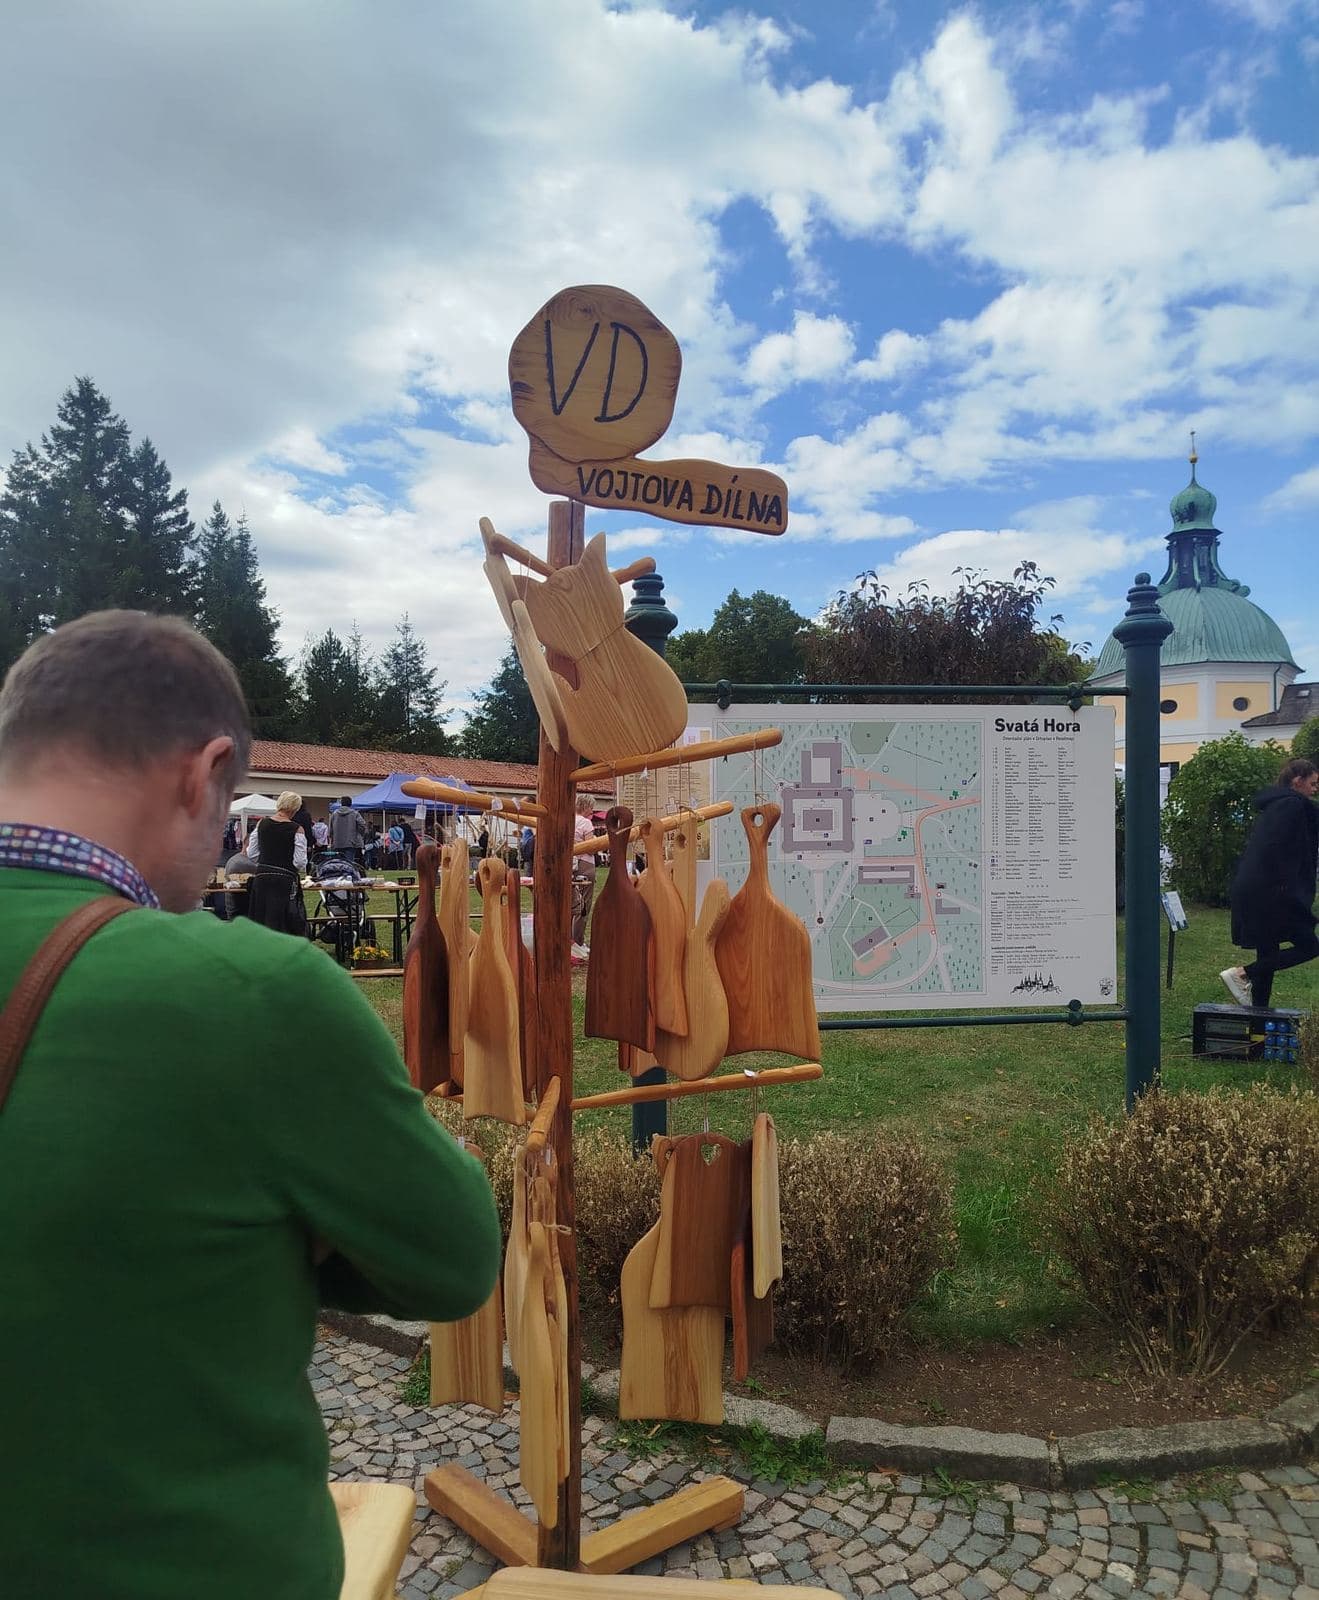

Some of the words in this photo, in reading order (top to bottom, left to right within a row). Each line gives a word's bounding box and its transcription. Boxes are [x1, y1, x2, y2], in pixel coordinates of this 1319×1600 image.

[544, 319, 648, 423] VD
[577, 466, 693, 512] VOJTOVA
[699, 474, 783, 526] DÍLNA
[994, 717, 1039, 733] Svatá
[1043, 718, 1081, 733] Hora
